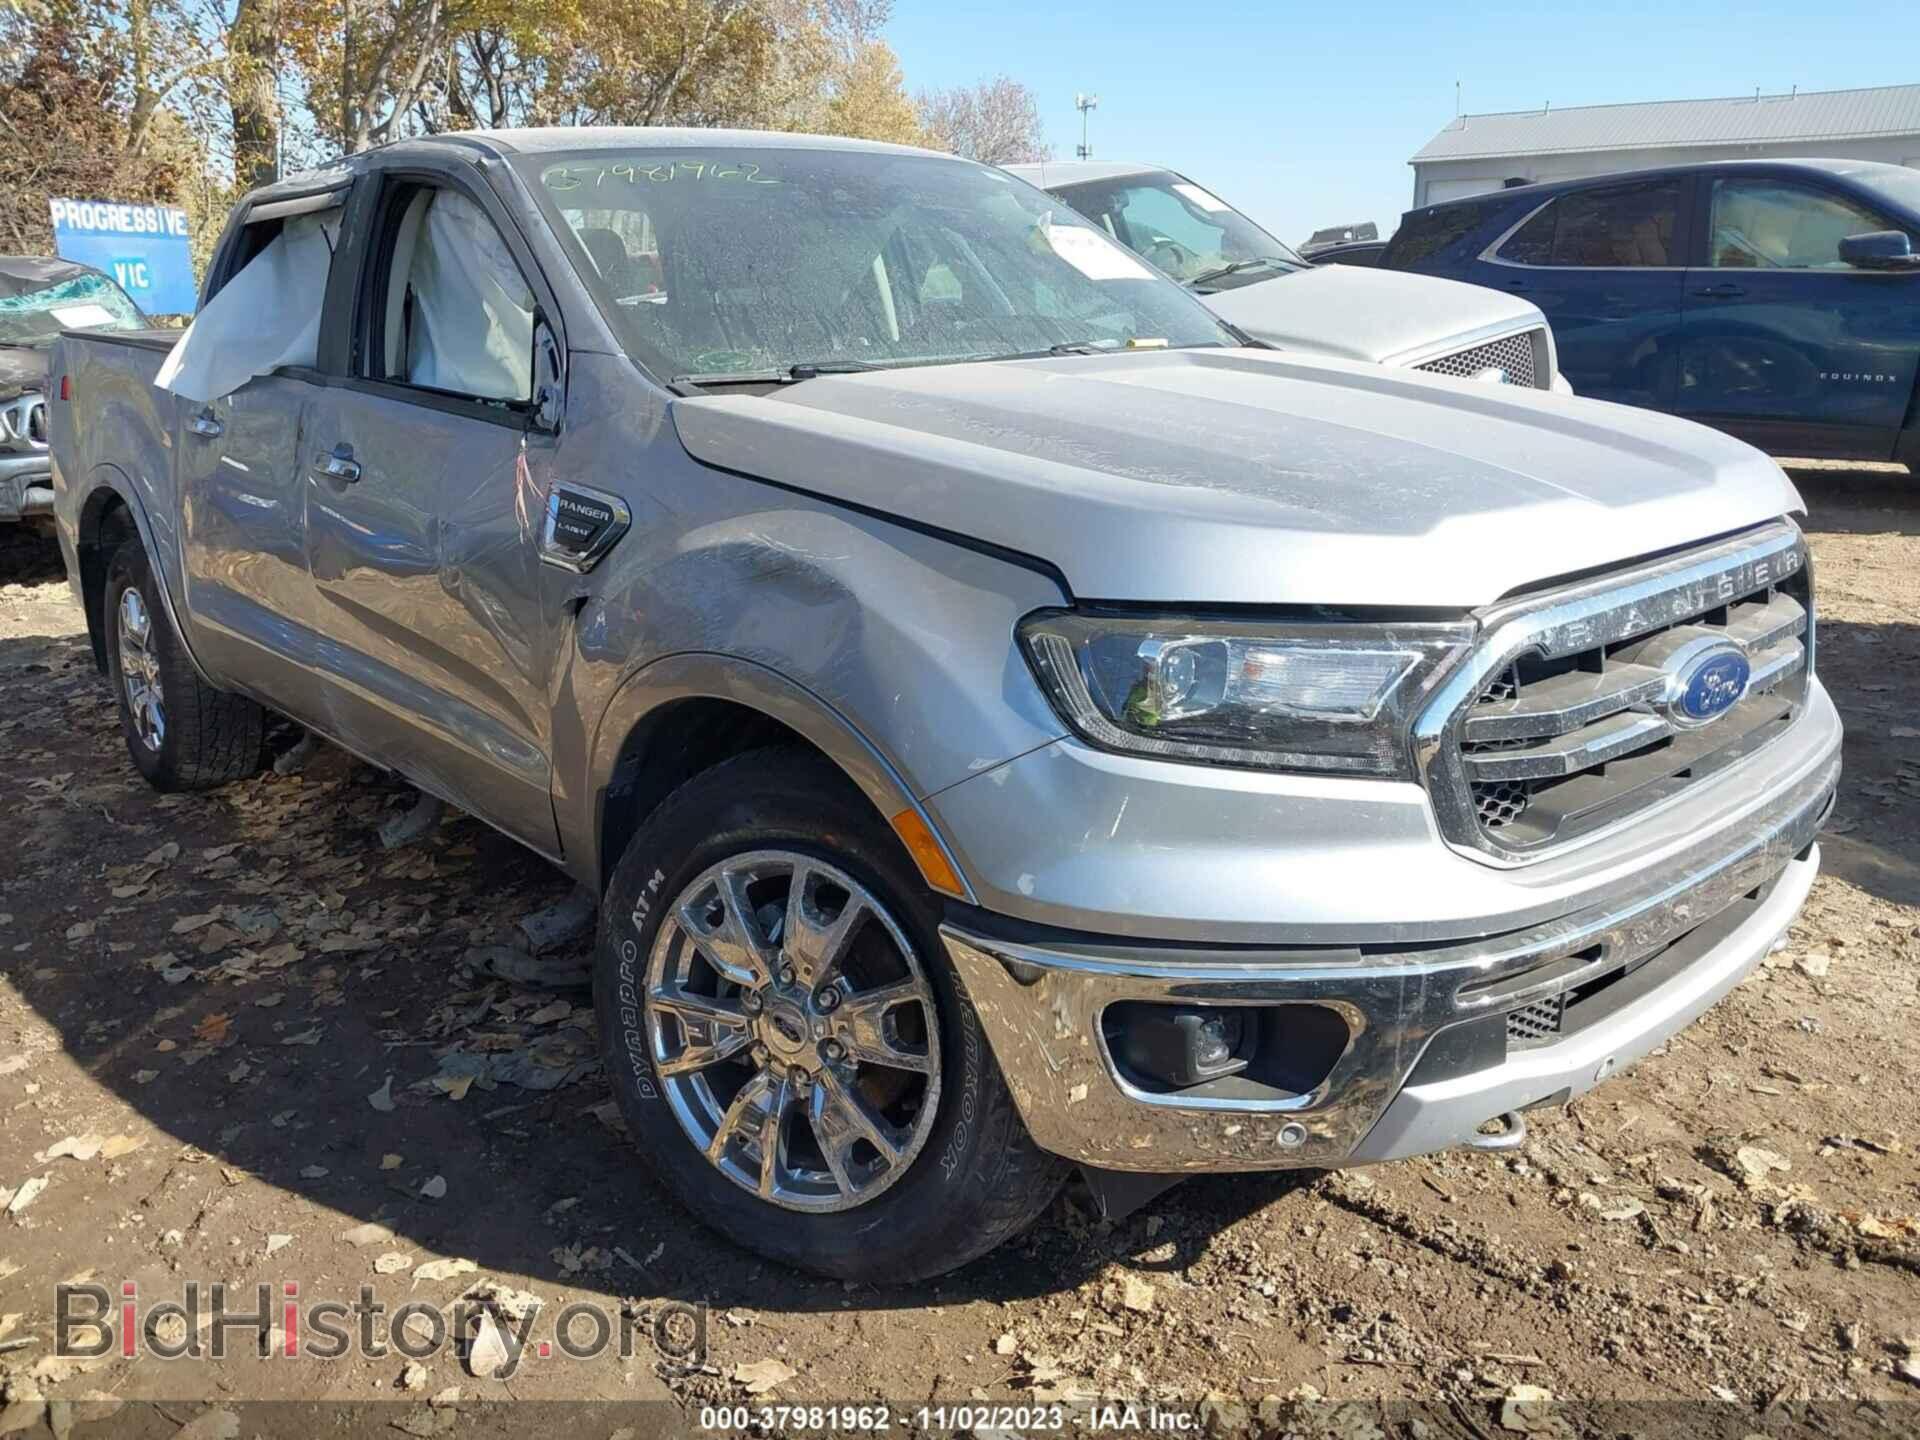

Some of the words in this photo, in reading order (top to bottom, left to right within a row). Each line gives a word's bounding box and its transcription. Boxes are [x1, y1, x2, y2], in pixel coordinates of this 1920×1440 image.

[50, 198, 188, 235] PROGRESSIVE
[113, 262, 149, 288] VIC
[1820, 372, 1897, 382] EQUINOX
[559, 499, 610, 521] RANGER
